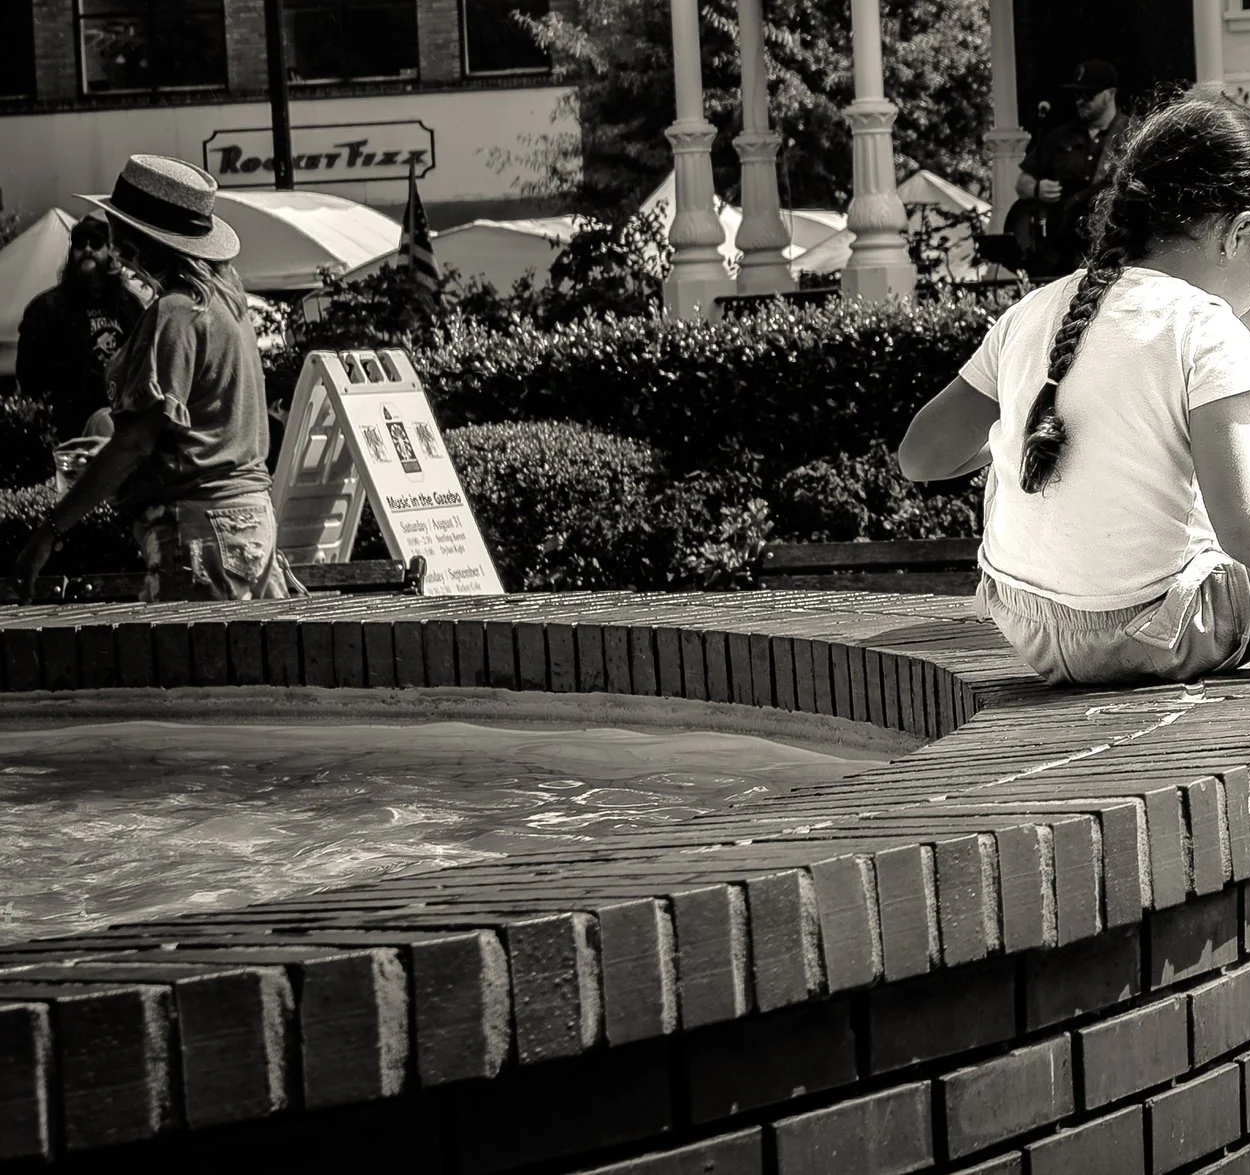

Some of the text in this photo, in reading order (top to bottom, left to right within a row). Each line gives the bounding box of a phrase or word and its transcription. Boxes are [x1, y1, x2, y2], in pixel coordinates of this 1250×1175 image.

[386, 490, 462, 509] Music in the Gazebo
[400, 520, 428, 534] Saturday
[432, 518, 454, 532] August
[448, 566, 480, 582] September
